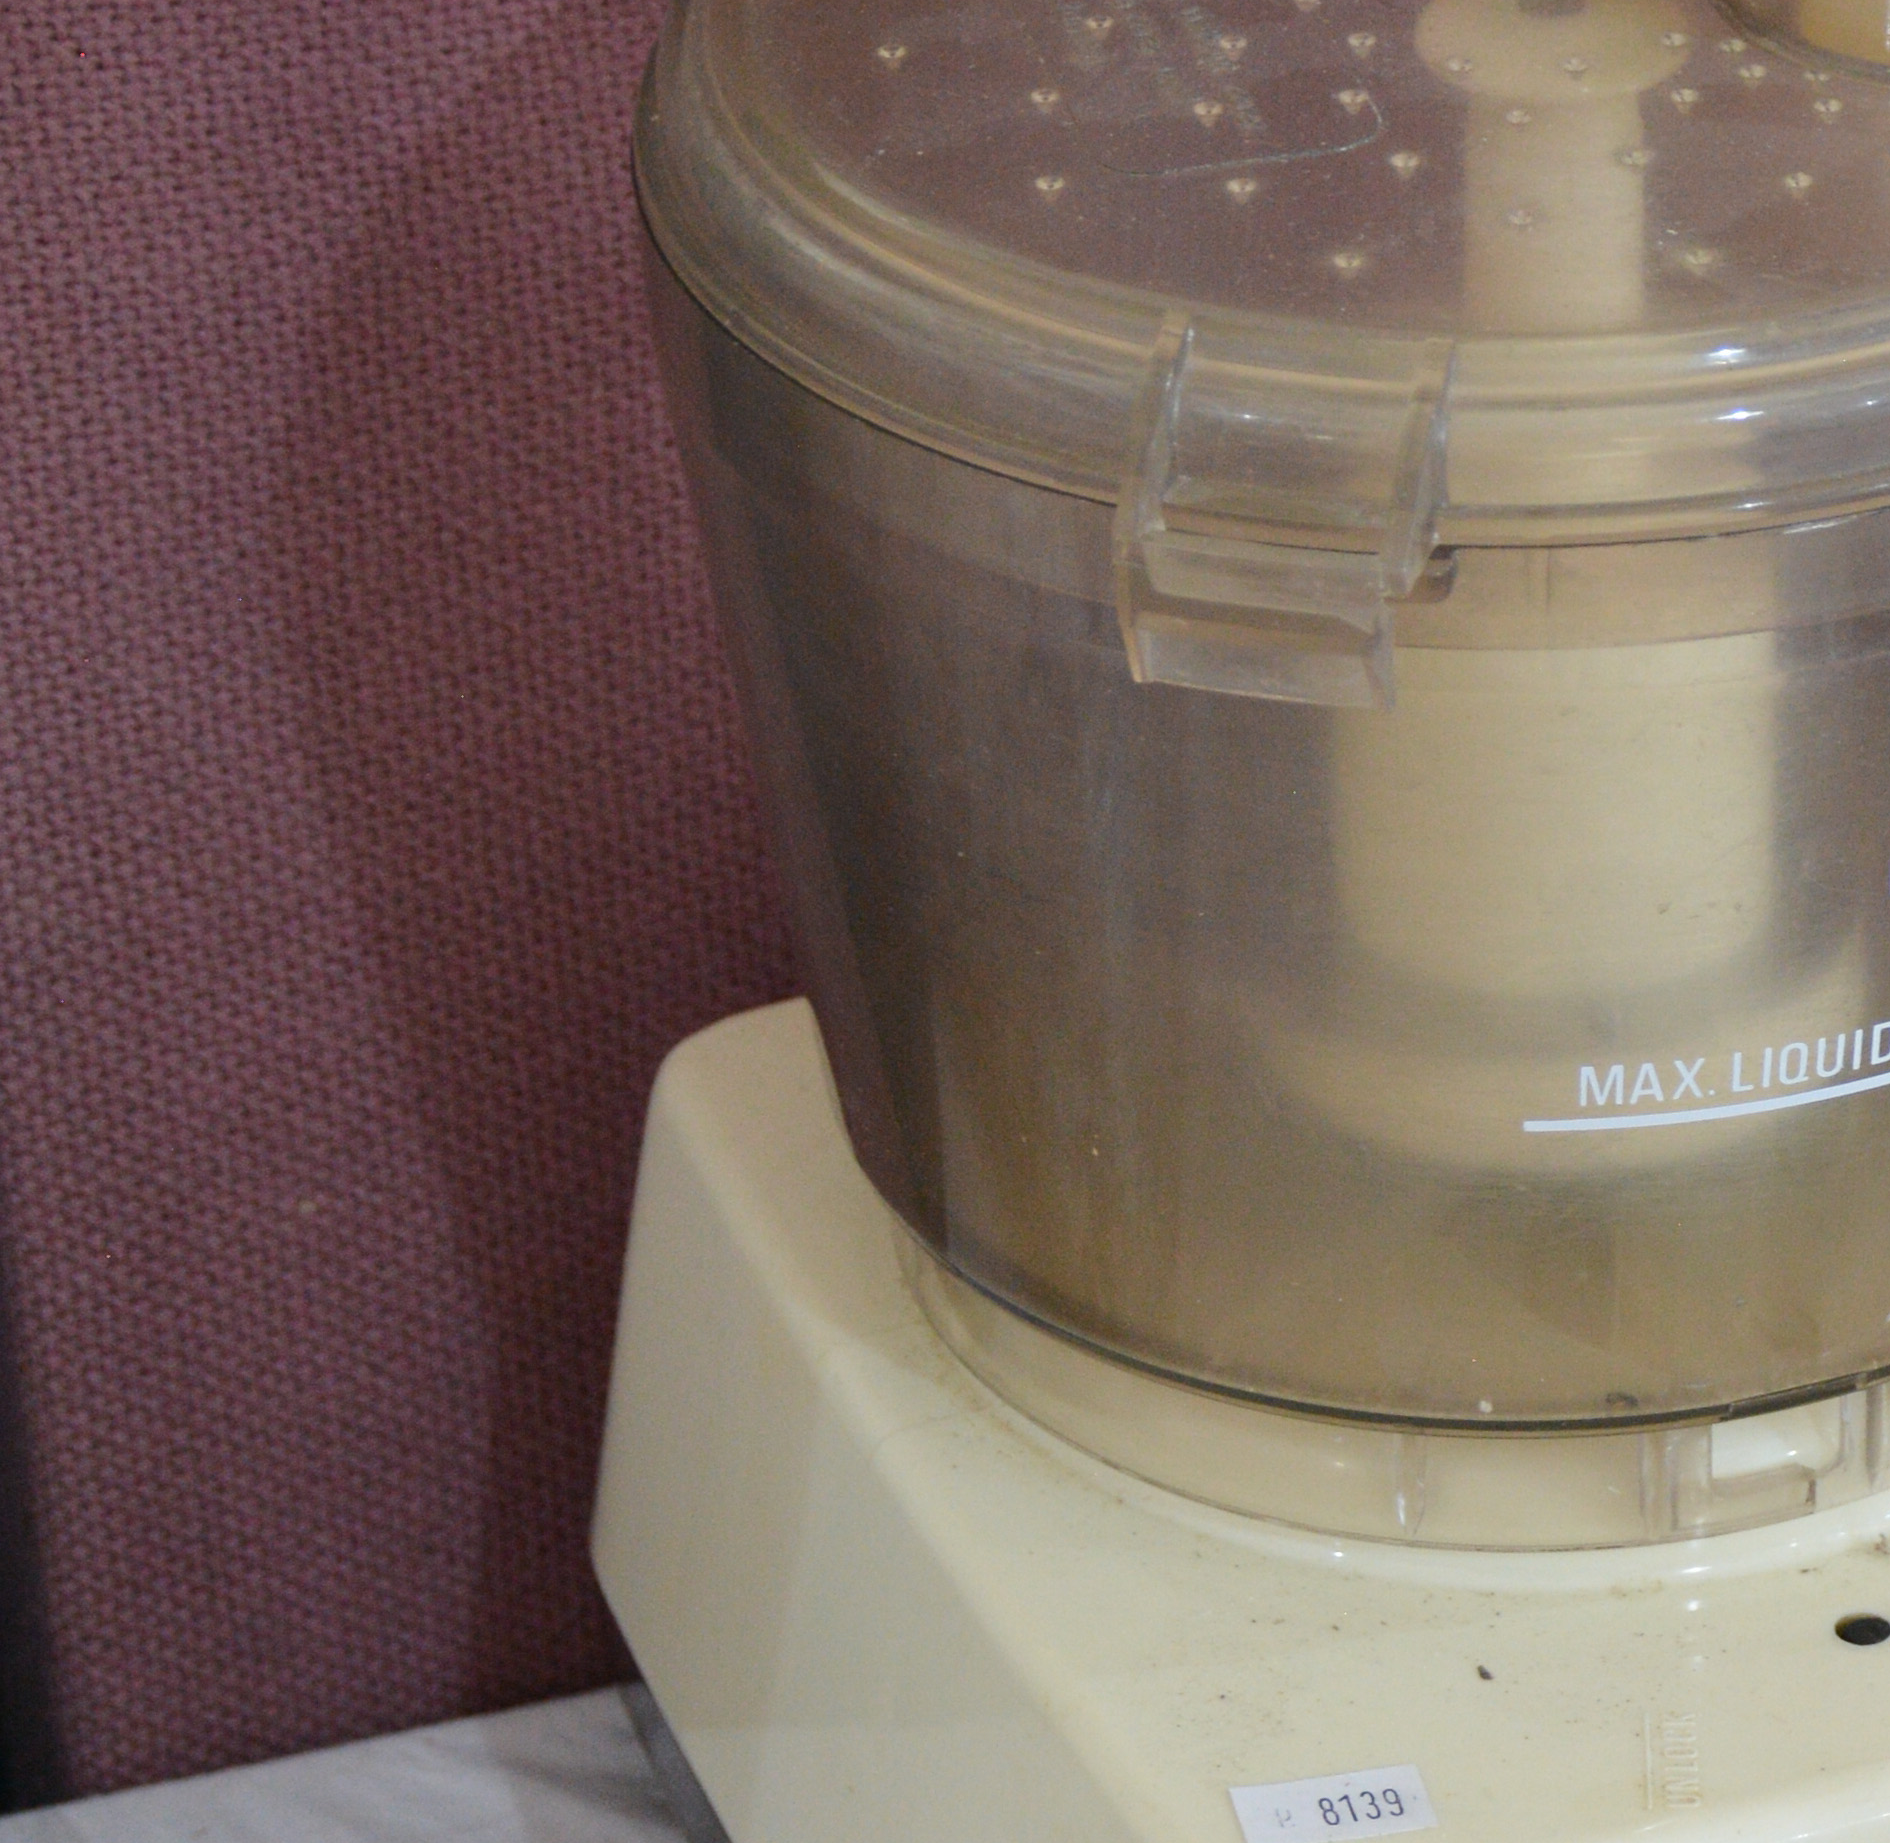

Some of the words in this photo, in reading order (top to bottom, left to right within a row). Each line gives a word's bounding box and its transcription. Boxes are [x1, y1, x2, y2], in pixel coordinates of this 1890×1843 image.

[1579, 1058, 1716, 1108] MAX.
[1663, 1713, 1701, 1810] UNLOCK
[1318, 1788, 1405, 1826] 8139
